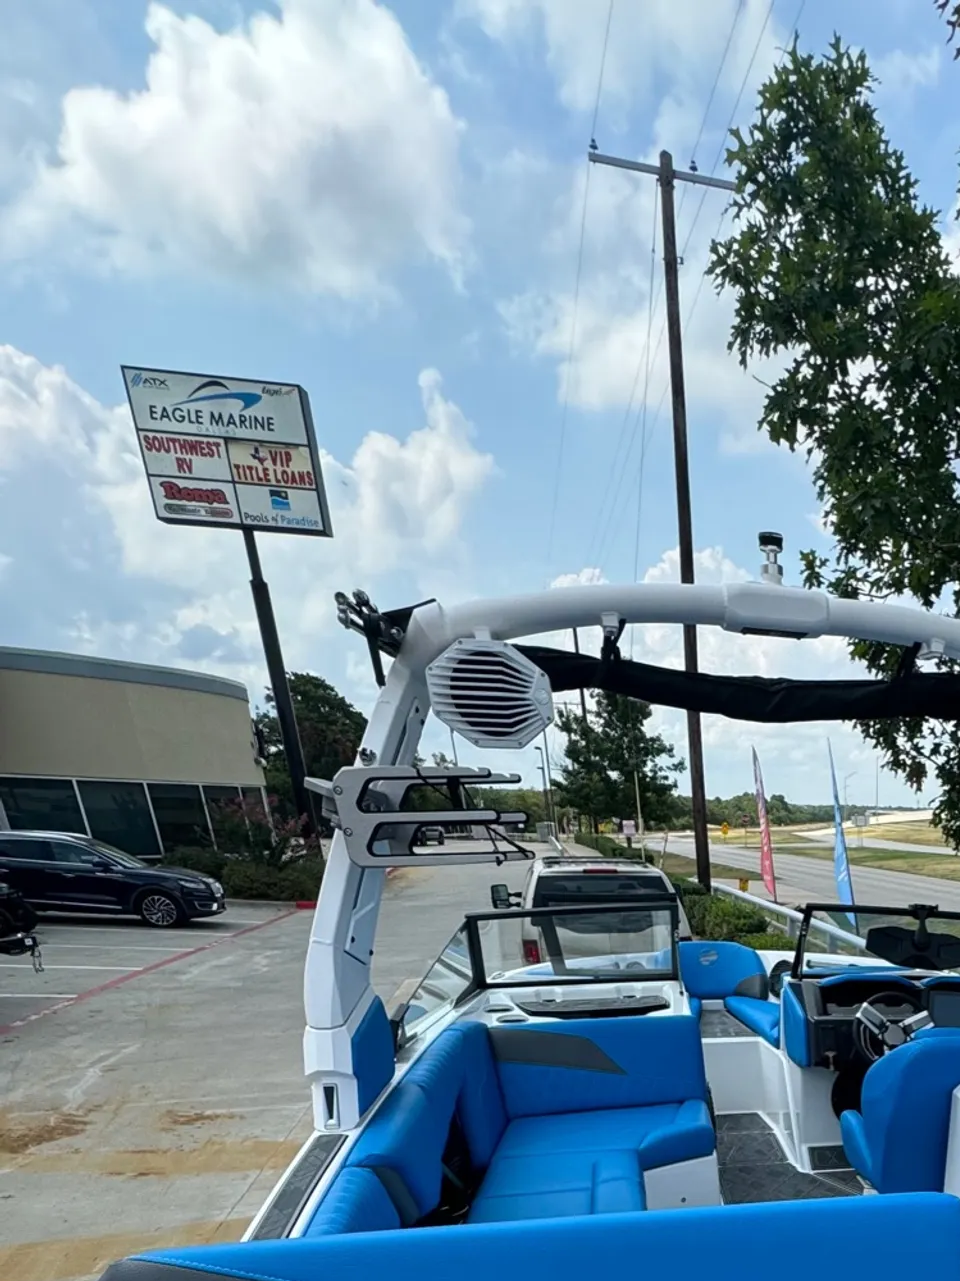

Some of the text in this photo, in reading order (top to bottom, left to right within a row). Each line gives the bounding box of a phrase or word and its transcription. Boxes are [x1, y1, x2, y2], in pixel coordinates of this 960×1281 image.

[142, 377, 168, 387] ATX
[149, 405, 275, 432] EAGLE MARINE
[143, 435, 221, 459] SOUTHWEST
[175, 457, 193, 474] RV
[268, 450, 292, 468] VIP
[233, 464, 314, 487] TITLE LOANS
[243, 512, 319, 527] Pools of Paradise
